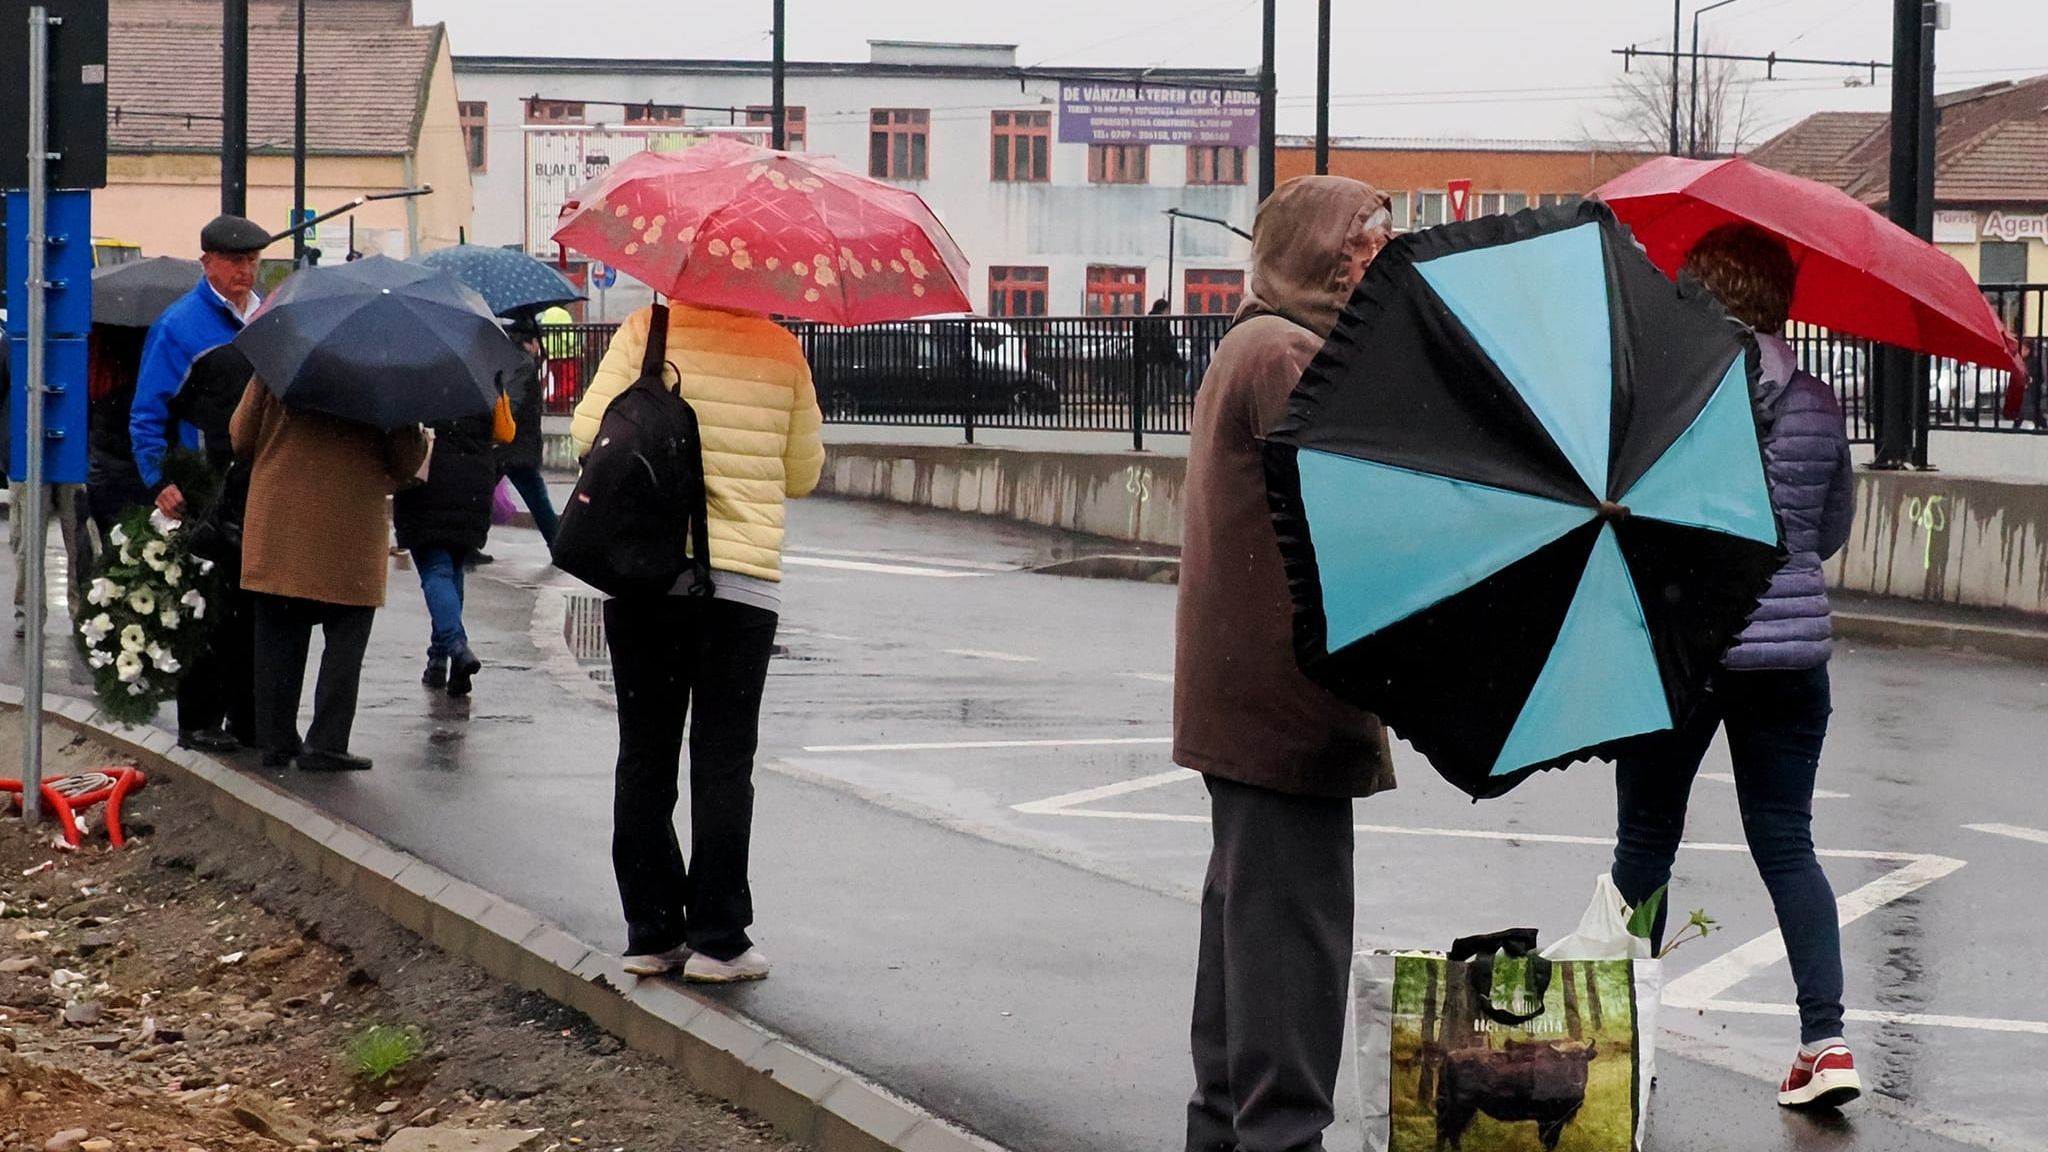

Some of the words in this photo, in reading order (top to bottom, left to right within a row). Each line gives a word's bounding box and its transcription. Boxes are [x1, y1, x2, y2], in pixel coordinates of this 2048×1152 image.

[1063, 87, 1080, 101] DE
[1146, 88, 1186, 104] TEREN
[1189, 90, 1207, 105] CU
[1989, 212, 2048, 237] Agen
